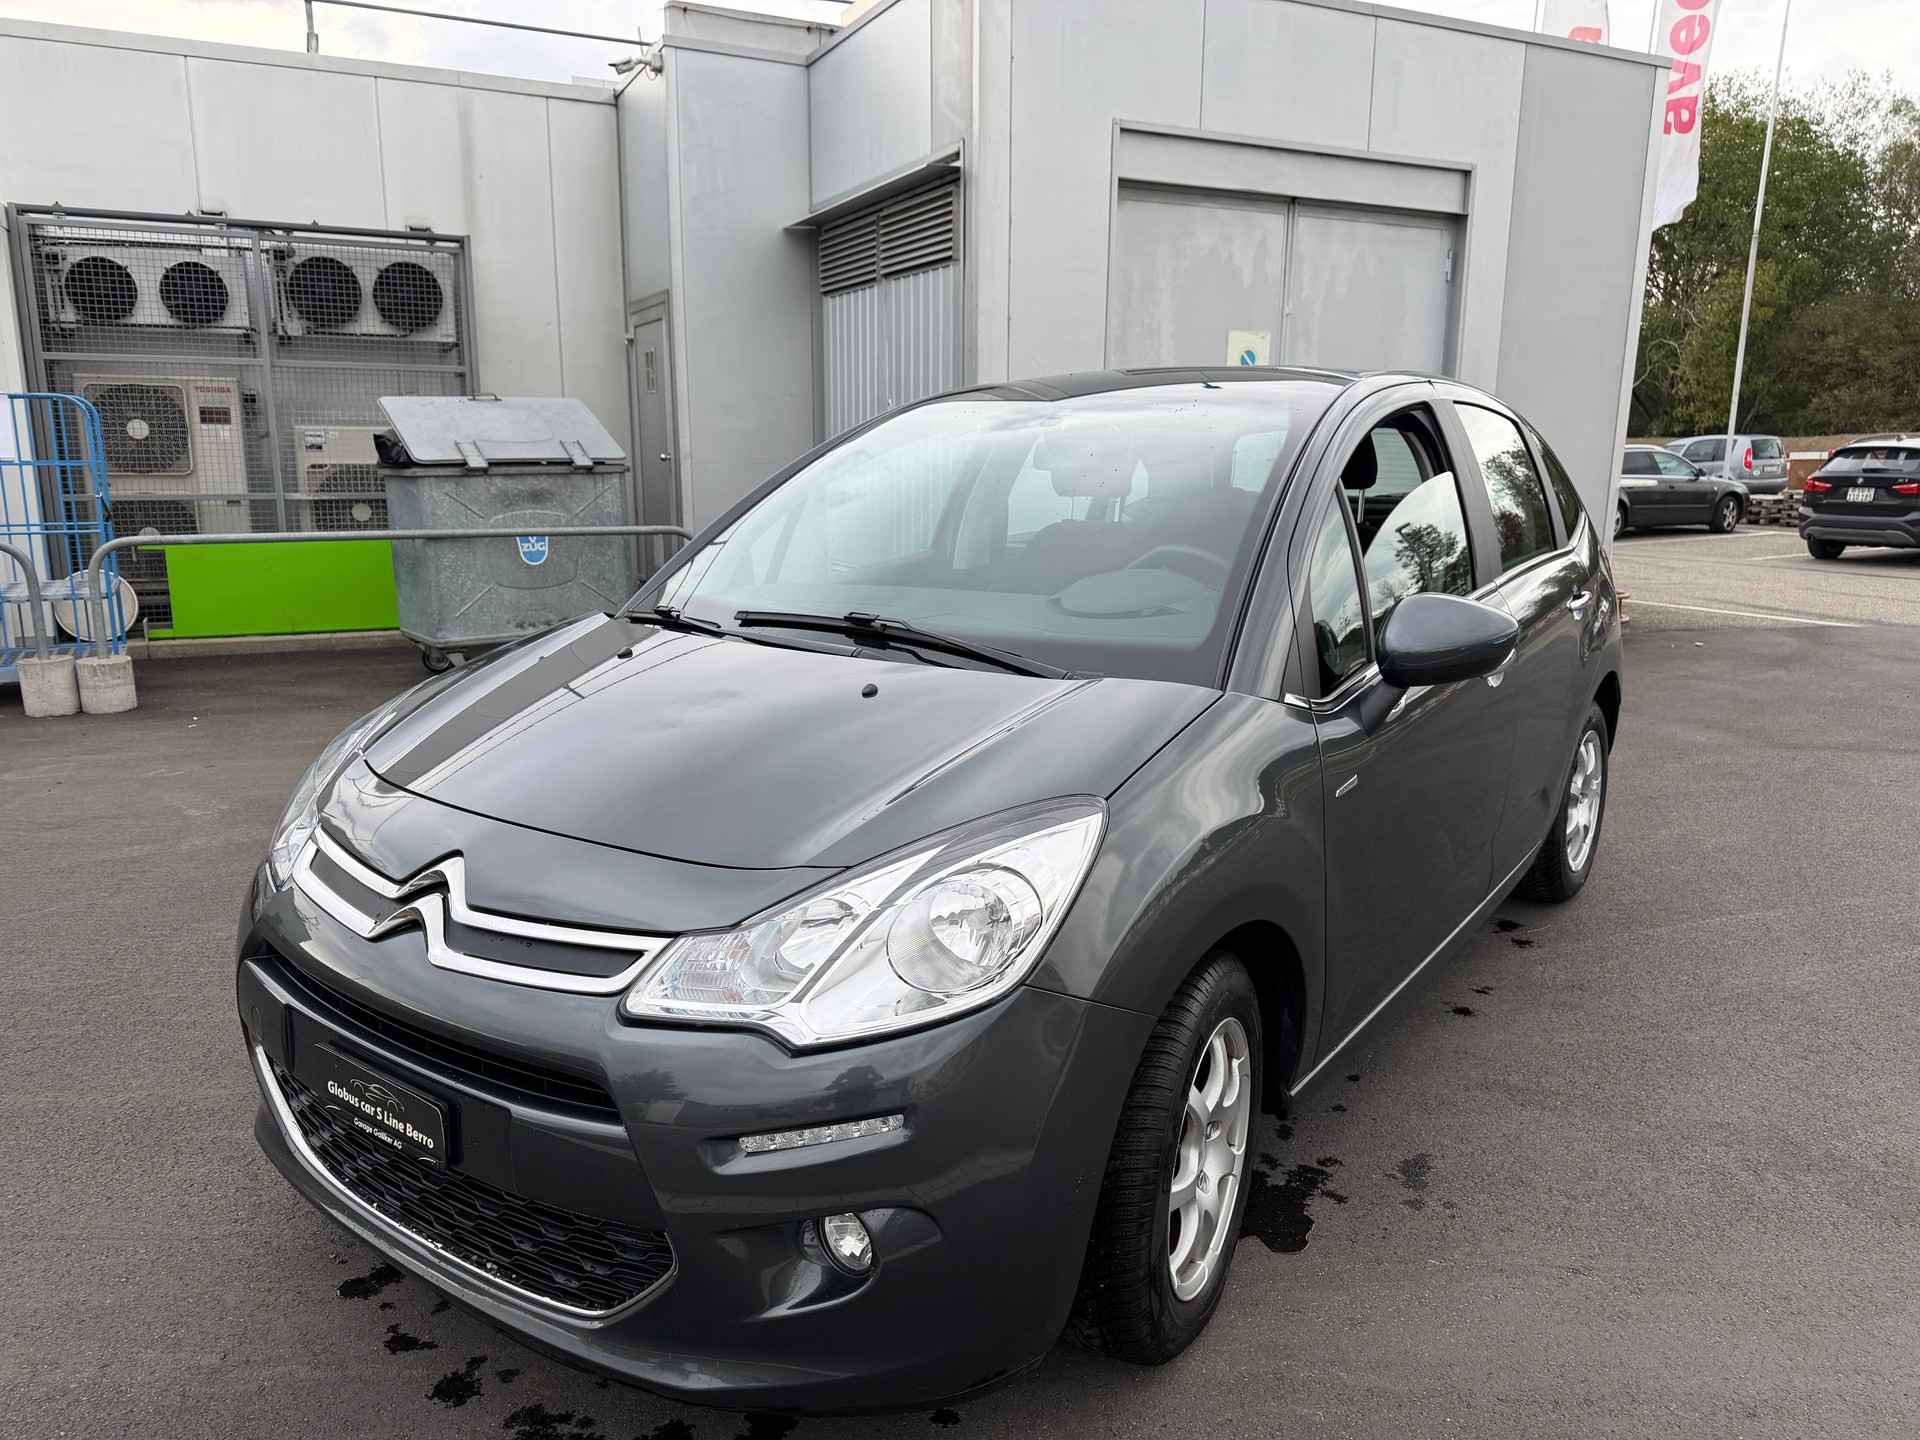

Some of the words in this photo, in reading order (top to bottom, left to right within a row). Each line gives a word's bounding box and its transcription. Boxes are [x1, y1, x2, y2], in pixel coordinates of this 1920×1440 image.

[1663, 0, 1711, 135] ave
[521, 542, 546, 552] ZUG
[327, 1080, 359, 1108] Globus
[360, 1101, 376, 1117] car
[376, 1106, 383, 1121] S
[384, 1110, 405, 1133] Line
[406, 1122, 434, 1149] Berro
[353, 1117, 373, 1134] Garage
[393, 1139, 402, 1150] AG
